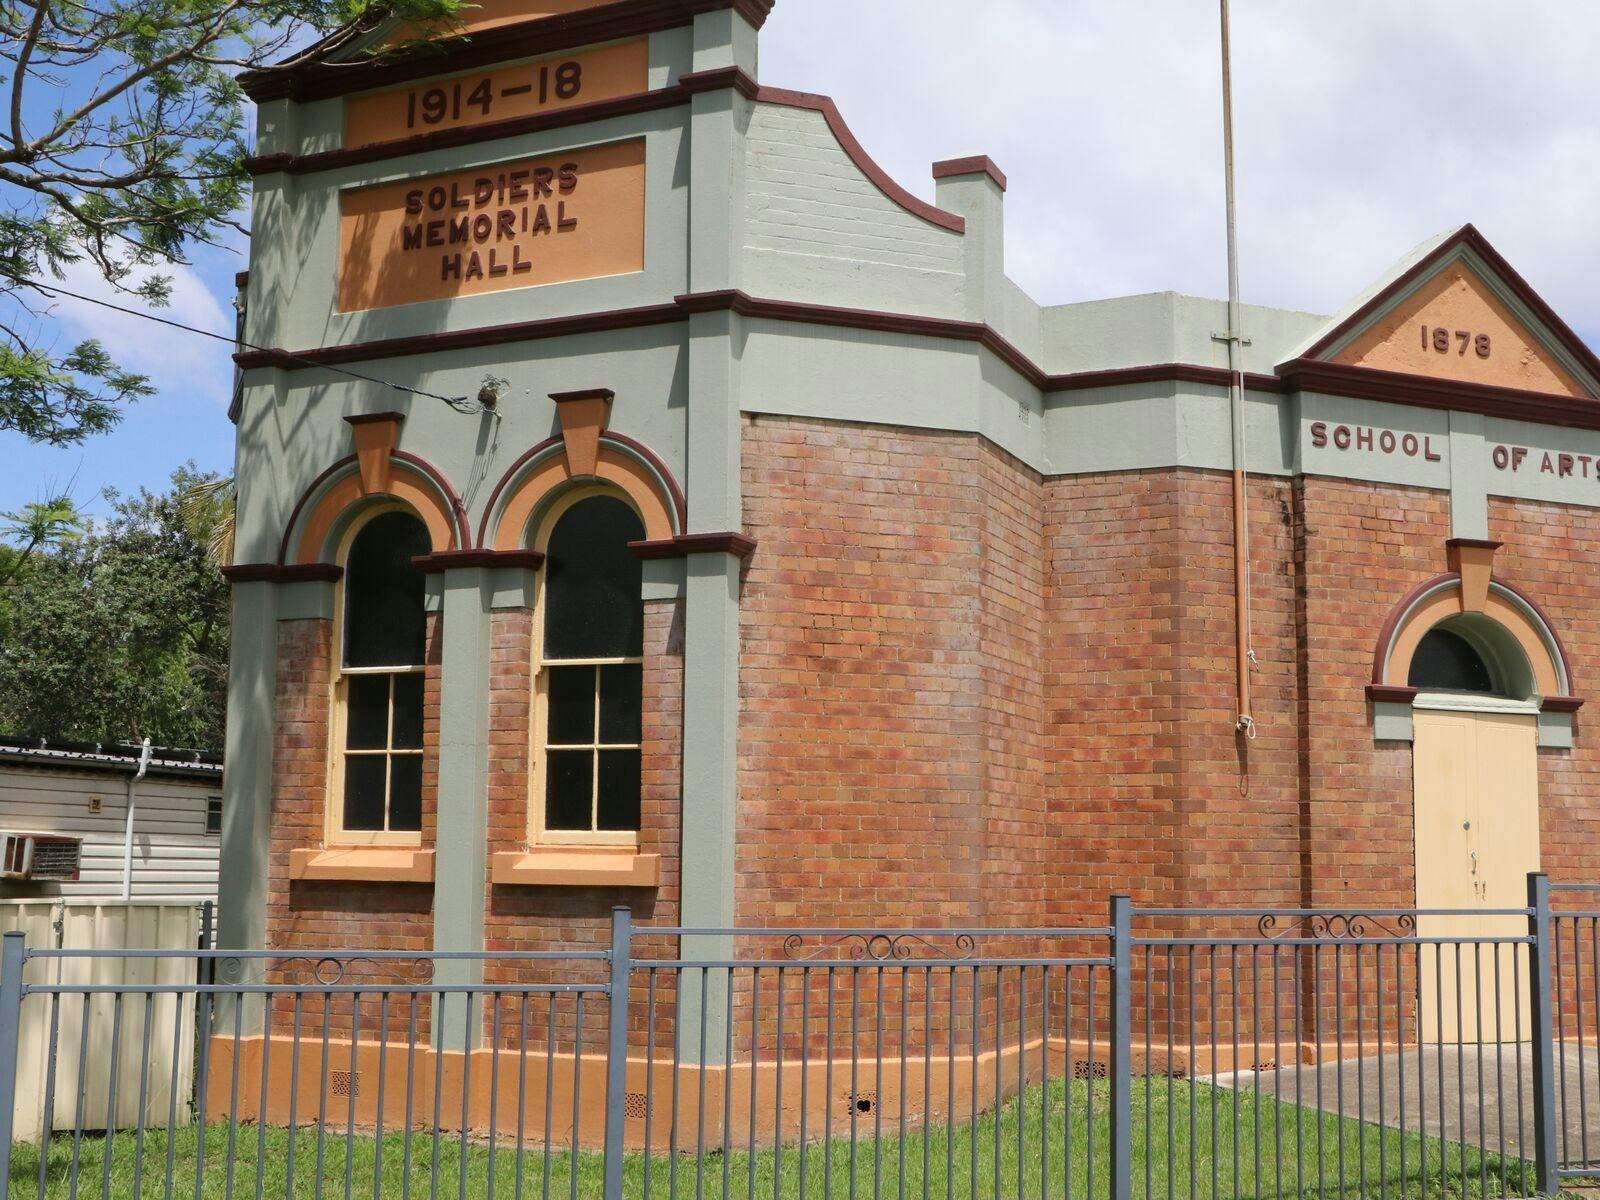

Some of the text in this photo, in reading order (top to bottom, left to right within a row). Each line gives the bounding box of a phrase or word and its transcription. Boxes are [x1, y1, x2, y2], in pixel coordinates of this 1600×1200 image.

[405, 163, 578, 214] SOLDIERS
[403, 201, 578, 250] MEMORIAL
[441, 245, 532, 280] HALL
[1421, 325, 1491, 357] 1878
[1311, 422, 1600, 482] SCHOOL OF ART
